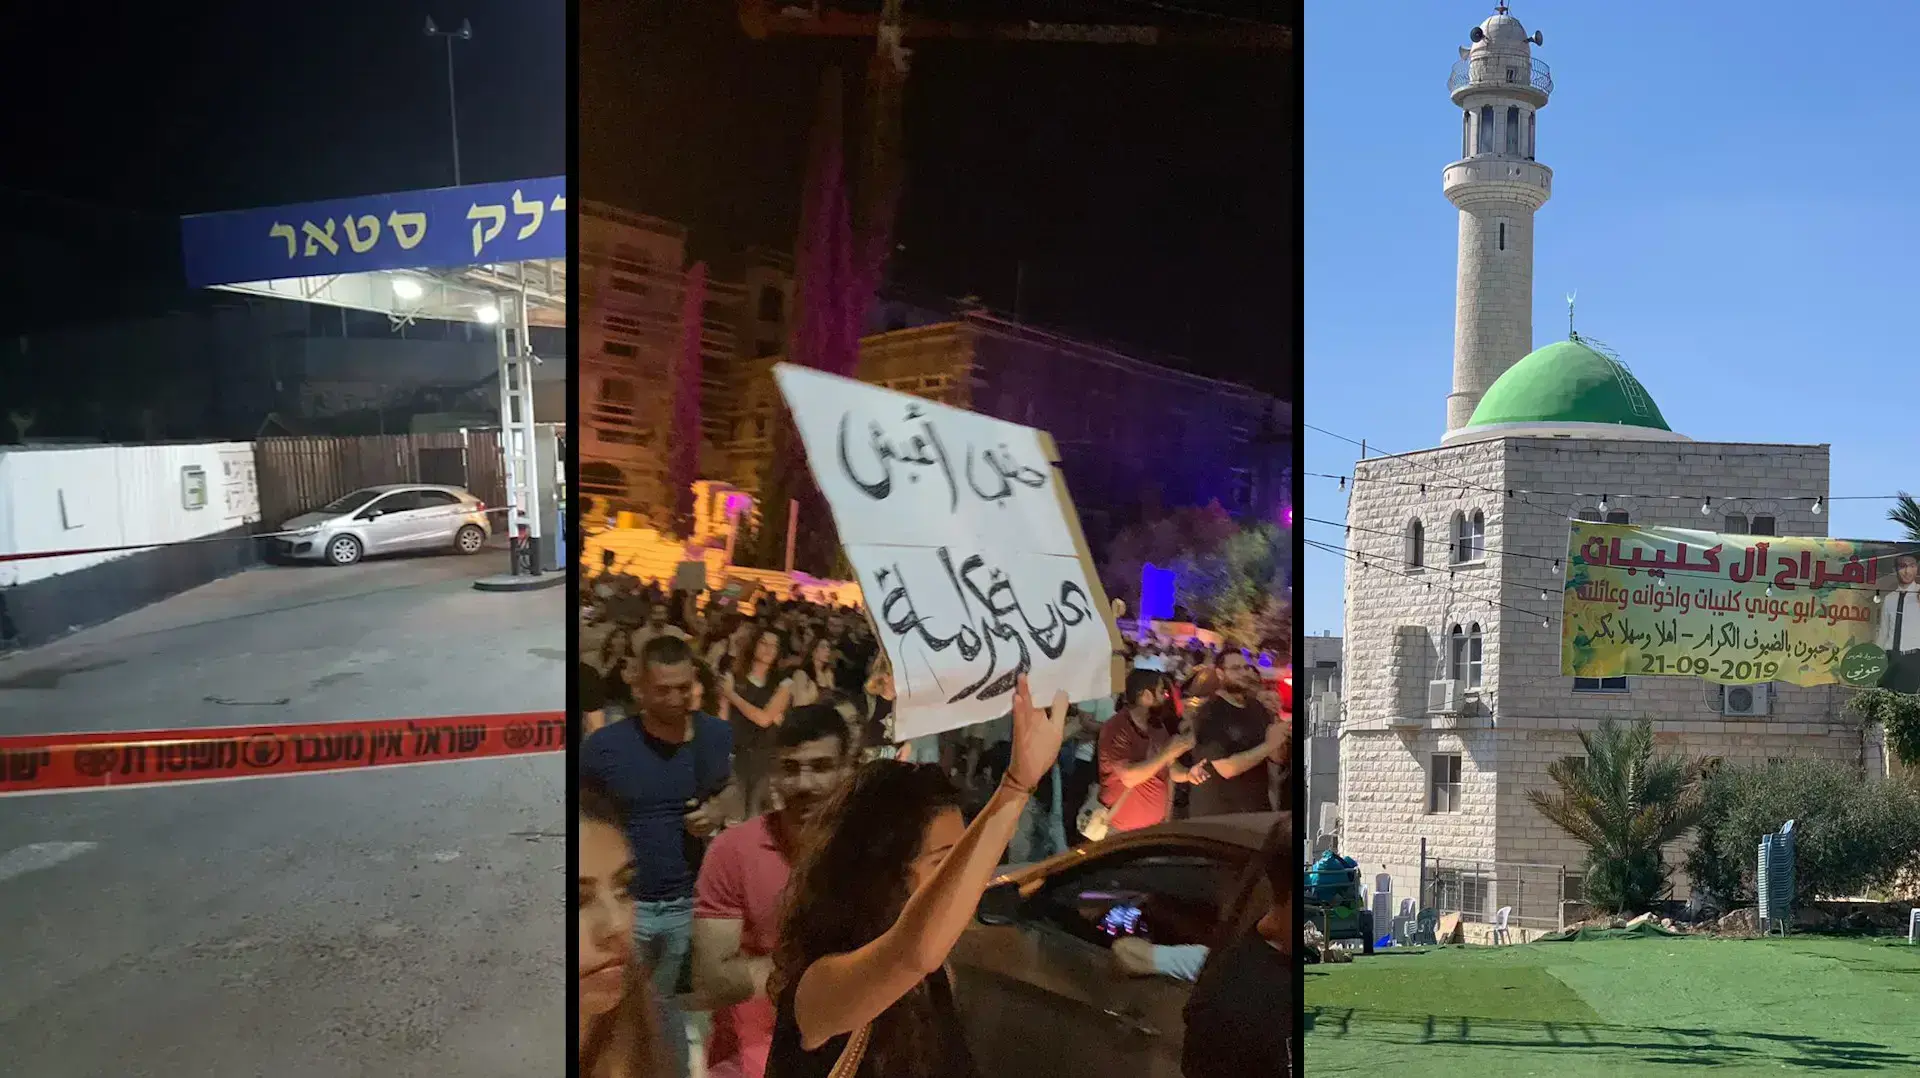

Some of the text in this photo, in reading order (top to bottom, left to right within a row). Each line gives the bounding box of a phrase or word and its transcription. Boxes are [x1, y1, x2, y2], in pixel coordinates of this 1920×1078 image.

[268, 209, 427, 260] סטאר
[1580, 536, 1878, 591] افراح آل كليبات
[1632, 584, 1690, 615] واخوانه
[1694, 589, 1742, 616] كليبات
[1745, 596, 1789, 622] عوني
[1792, 596, 1816, 623] ابو
[1818, 602, 1871, 626] محمود
[1618, 617, 1652, 650] وسهلا
[1693, 621, 1740, 656] الكرام
[1744, 629, 1791, 660] بالضيوف
[1641, 653, 1779, 680] 21-09-2019
[1794, 640, 1840, 665] يرحبون
[407, 720, 487, 756] ישראל
